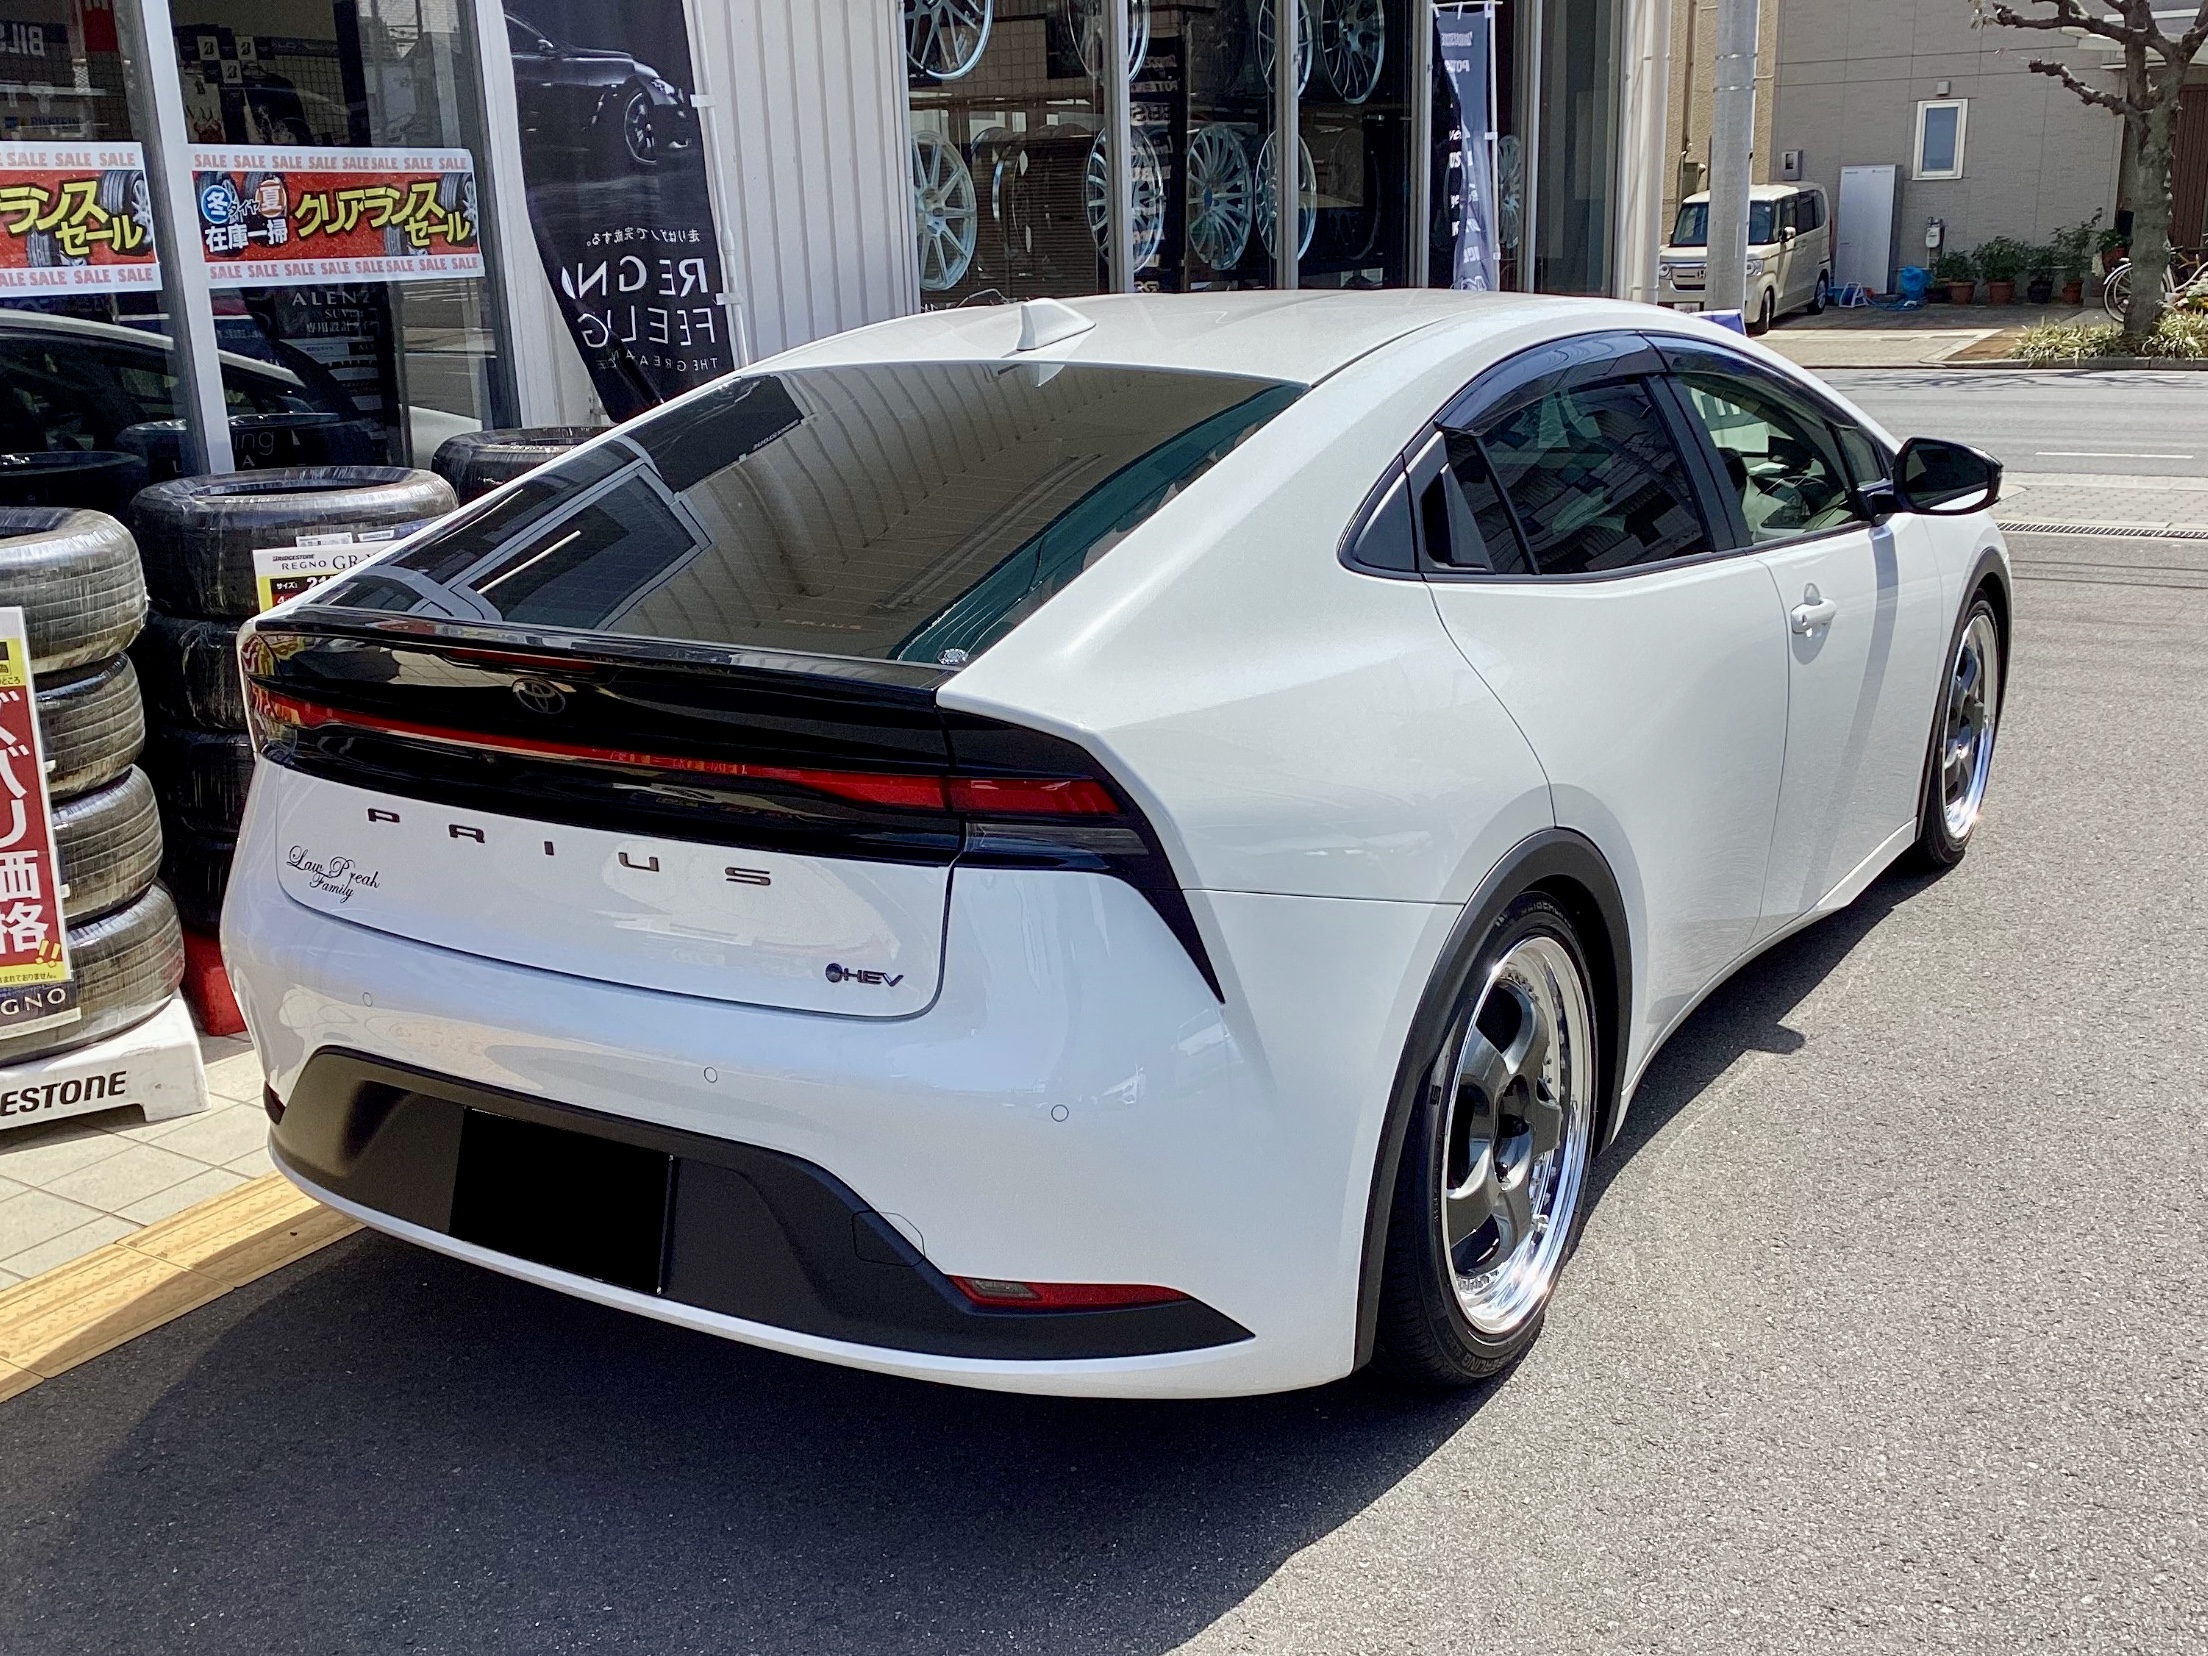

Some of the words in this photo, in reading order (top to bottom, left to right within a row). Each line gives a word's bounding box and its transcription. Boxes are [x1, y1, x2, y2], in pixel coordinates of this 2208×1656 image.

[7, 152, 47, 167] SALE
[55, 153, 92, 167] SALE
[100, 153, 135, 167] SALE
[194, 154, 227, 168] SALE
[234, 155, 266, 168] SALE
[272, 156, 302, 169] SALE
[308, 157, 337, 169] SALE
[342, 157, 368, 170] SALE
[371, 157, 398, 170] SALE
[404, 158, 433, 170] SALE
[438, 158, 467, 170] SALE
[295, 182, 445, 238] クリアランス
[55, 214, 142, 256] セール
[204, 218, 288, 252] 在庫一掃
[404, 212, 470, 247] セール
[0, 272, 26, 287] ALE
[29, 271, 67, 286] SALE
[74, 269, 112, 284] SALE
[118, 267, 152, 282] SALE
[210, 265, 242, 279] SALE
[247, 264, 279, 278] SALE
[284, 263, 315, 276] SALE
[321, 261, 350, 275] SALE
[355, 260, 384, 273] SALE
[386, 259, 414, 272] SALE
[420, 258, 447, 271] SALE
[452, 257, 478, 270] SALE
[292, 291, 371, 307] ALENZ
[281, 560, 327, 570] REGNO
[367, 807, 772, 886] PRIUS
[309, 874, 354, 903] Family
[844, 968, 904, 987] HEV
[0, 1070, 127, 1117] ESTONE
